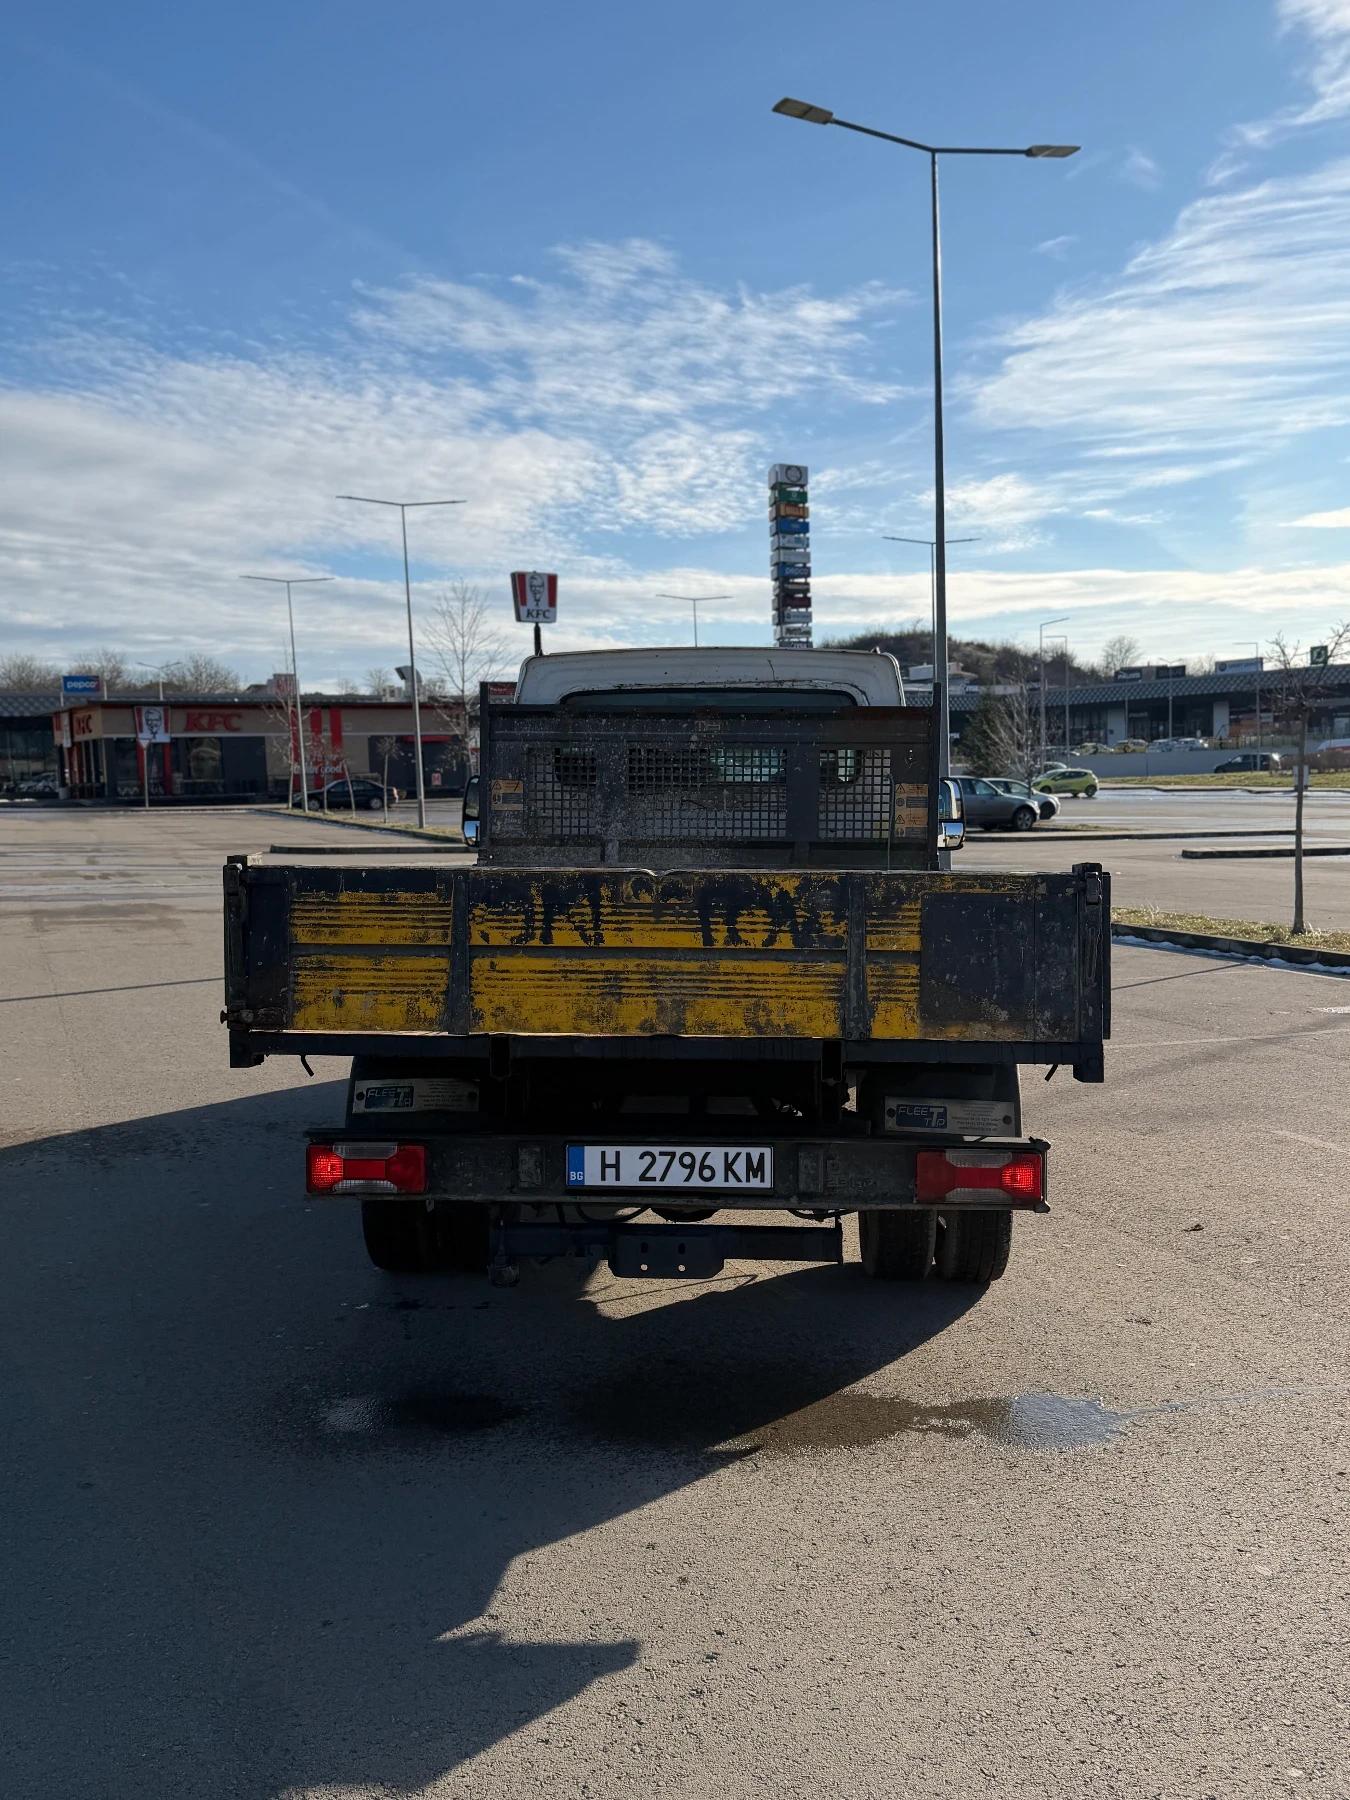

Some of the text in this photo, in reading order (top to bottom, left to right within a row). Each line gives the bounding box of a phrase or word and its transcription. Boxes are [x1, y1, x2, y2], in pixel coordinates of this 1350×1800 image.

[526, 608, 551, 619] KFC
[66, 680, 97, 690] pepco
[184, 711, 243, 733] KFC
[600, 1151, 765, 1183] H 2796 KM
[569, 1171, 584, 1181] BG
